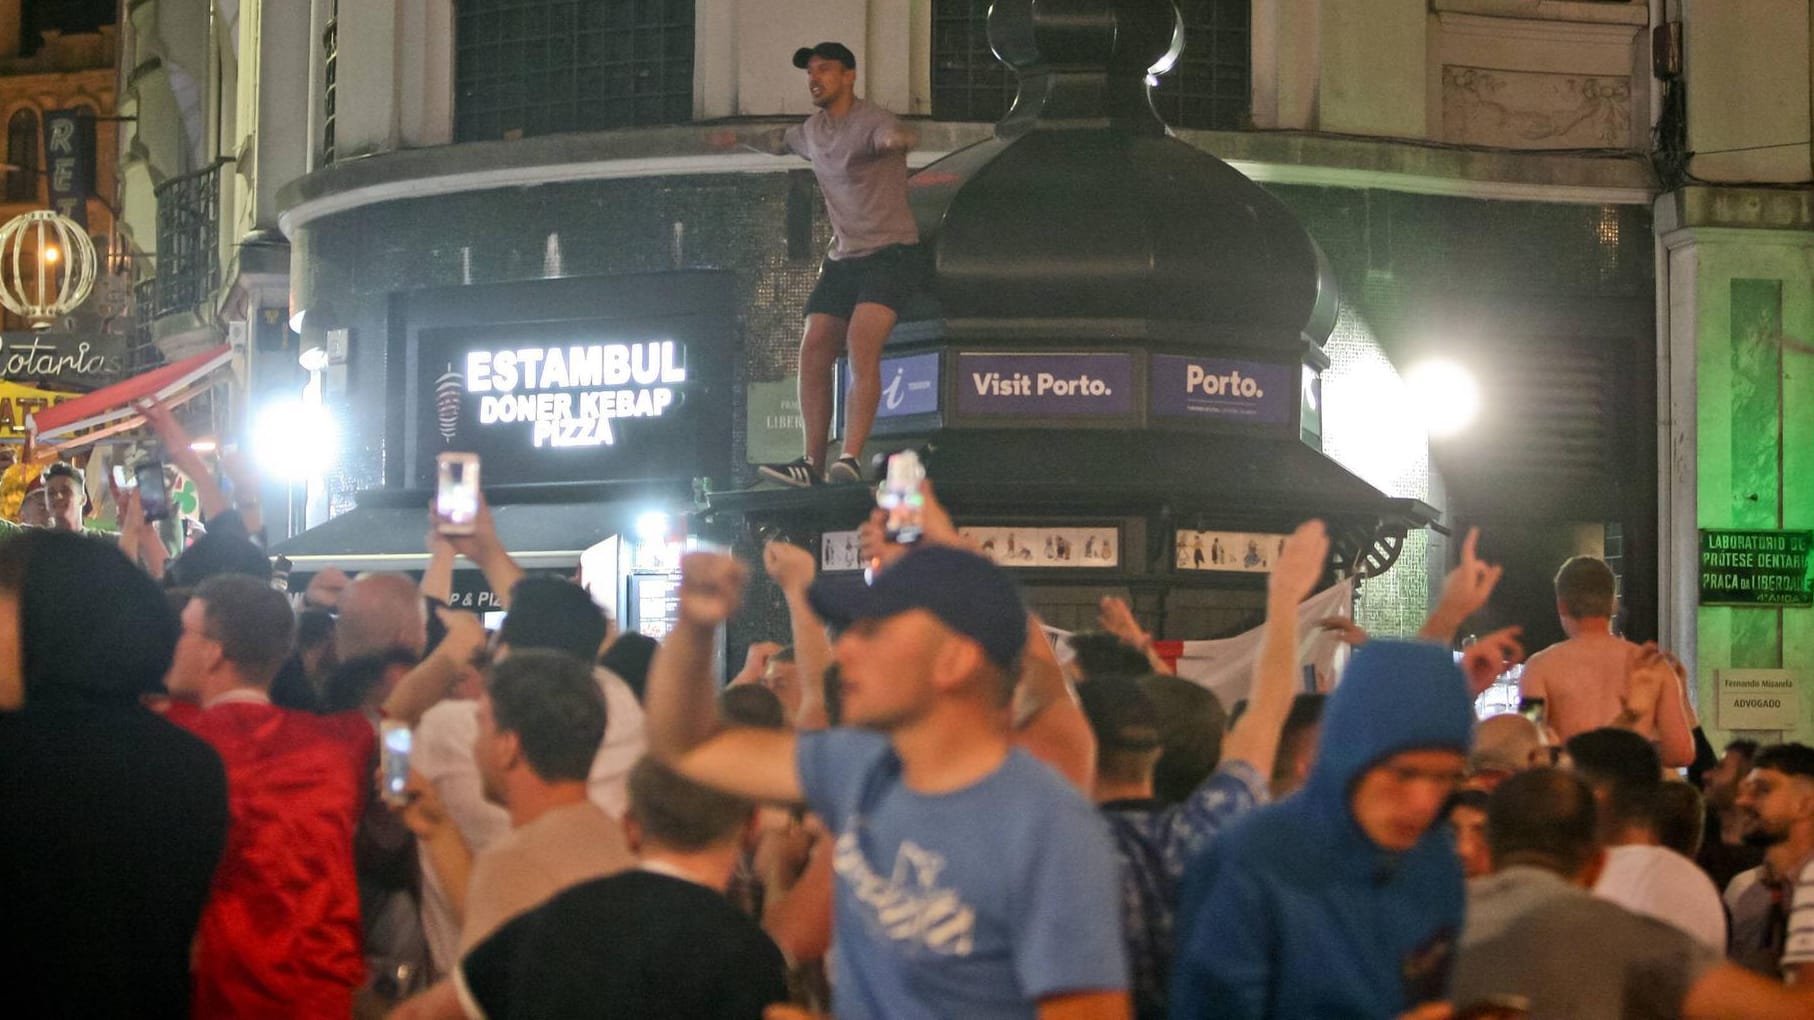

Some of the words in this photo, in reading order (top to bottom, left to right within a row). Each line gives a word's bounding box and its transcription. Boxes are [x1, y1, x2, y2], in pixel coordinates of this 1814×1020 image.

[0, 336, 121, 377] otarias
[466, 341, 687, 393] ESTAMBUL
[973, 373, 1032, 396] Visit
[1036, 373, 1112, 396] Porto.
[1186, 364, 1264, 399] Porto.
[480, 392, 572, 424] DONER
[579, 387, 672, 420] KEBAP
[533, 417, 615, 448] PIZZA
[1725, 679, 1760, 688] Fernando
[1734, 699, 1781, 708] ADVOGADO
